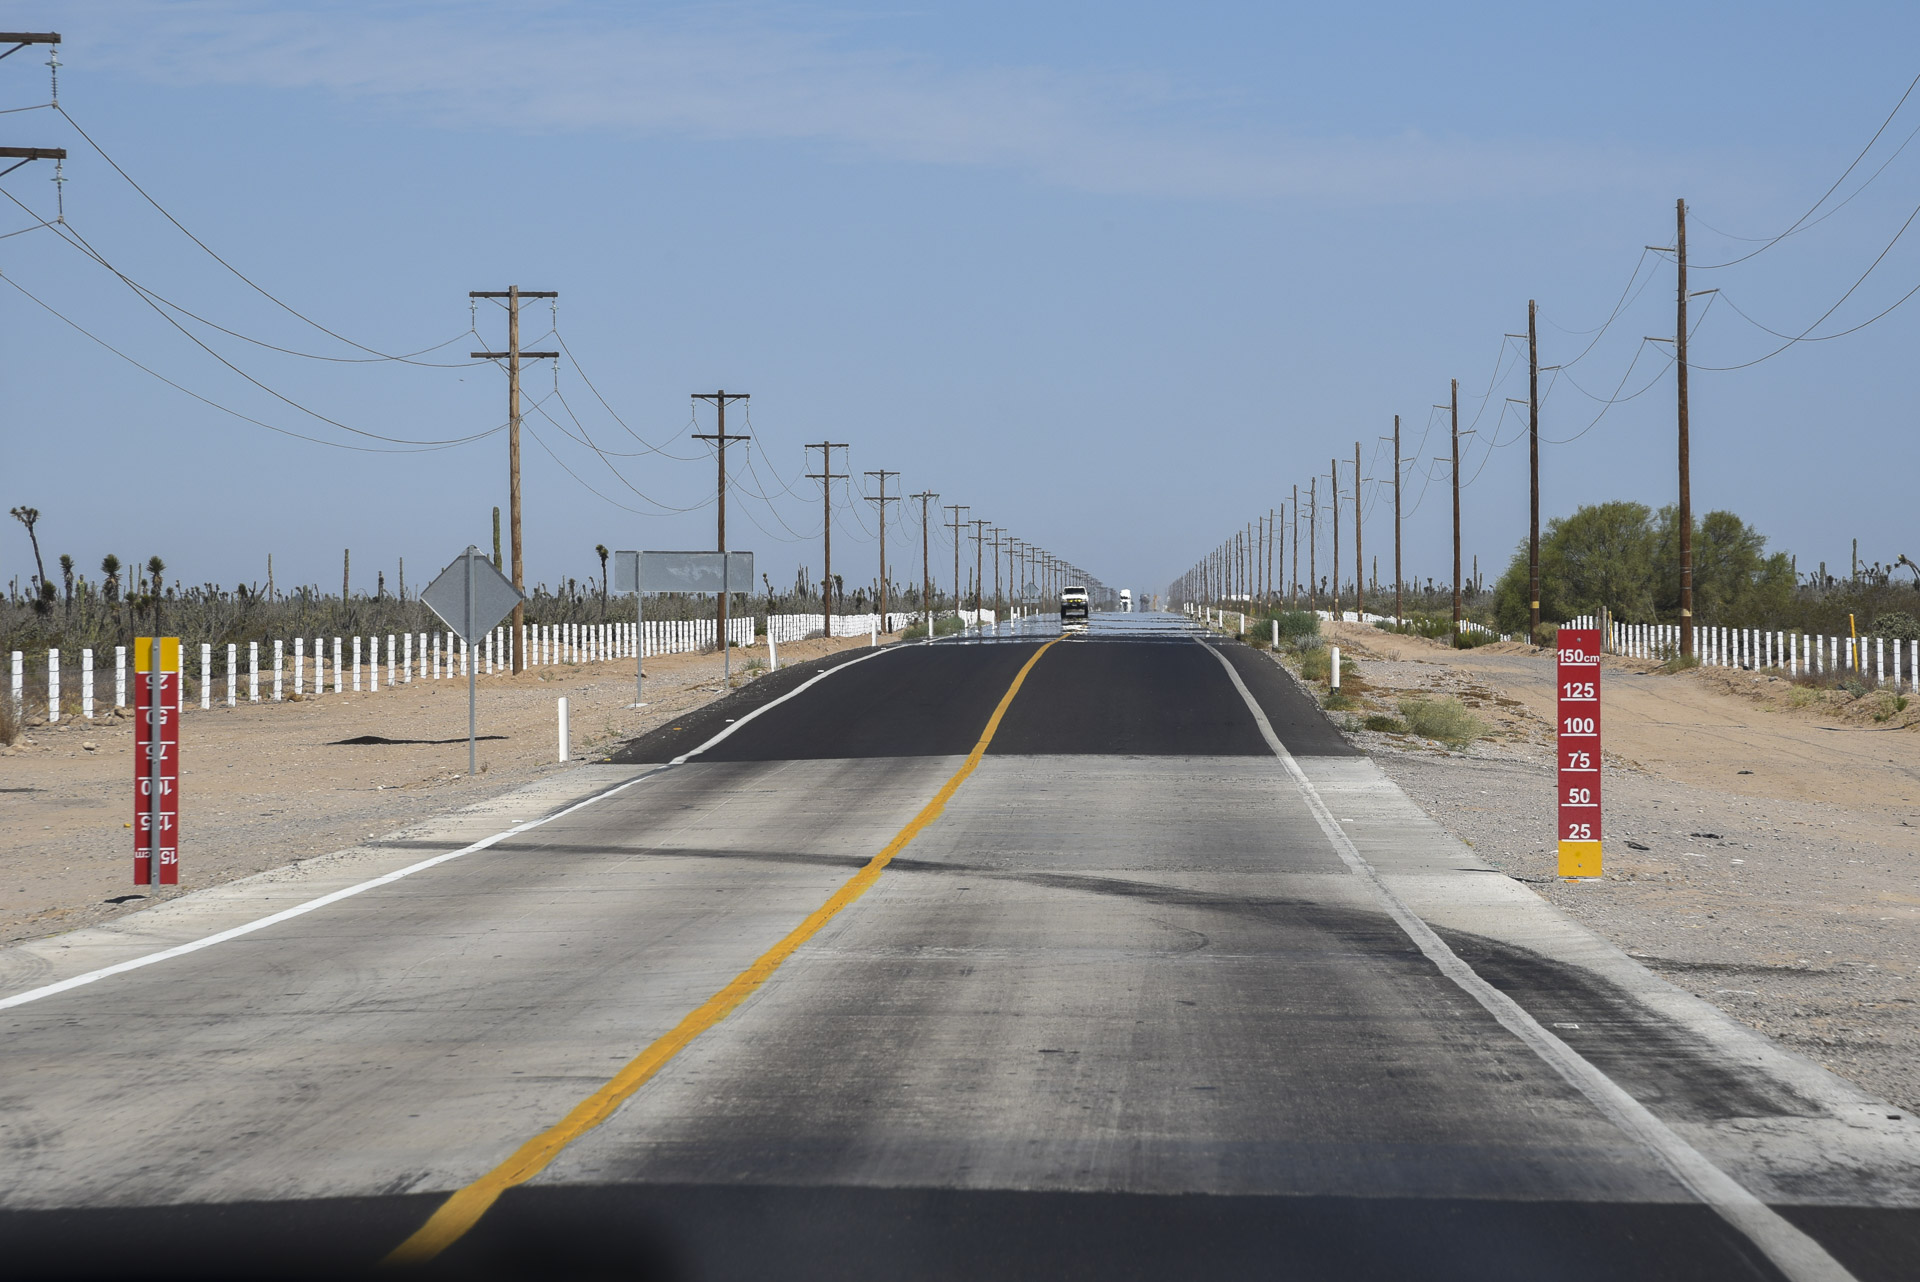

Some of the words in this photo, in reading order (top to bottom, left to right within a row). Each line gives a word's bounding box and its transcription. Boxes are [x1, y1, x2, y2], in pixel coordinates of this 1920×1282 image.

[1557, 649, 1600, 663] 150cm
[145, 675, 169, 690] 25
[1563, 682, 1595, 698] 125
[145, 709, 168, 725] 50
[1564, 717, 1594, 733] 100
[145, 744, 168, 760] 75
[1568, 752, 1590, 768] 75
[141, 780, 172, 795] 10
[1568, 788, 1590, 803] 50
[1568, 823, 1591, 839] 25
